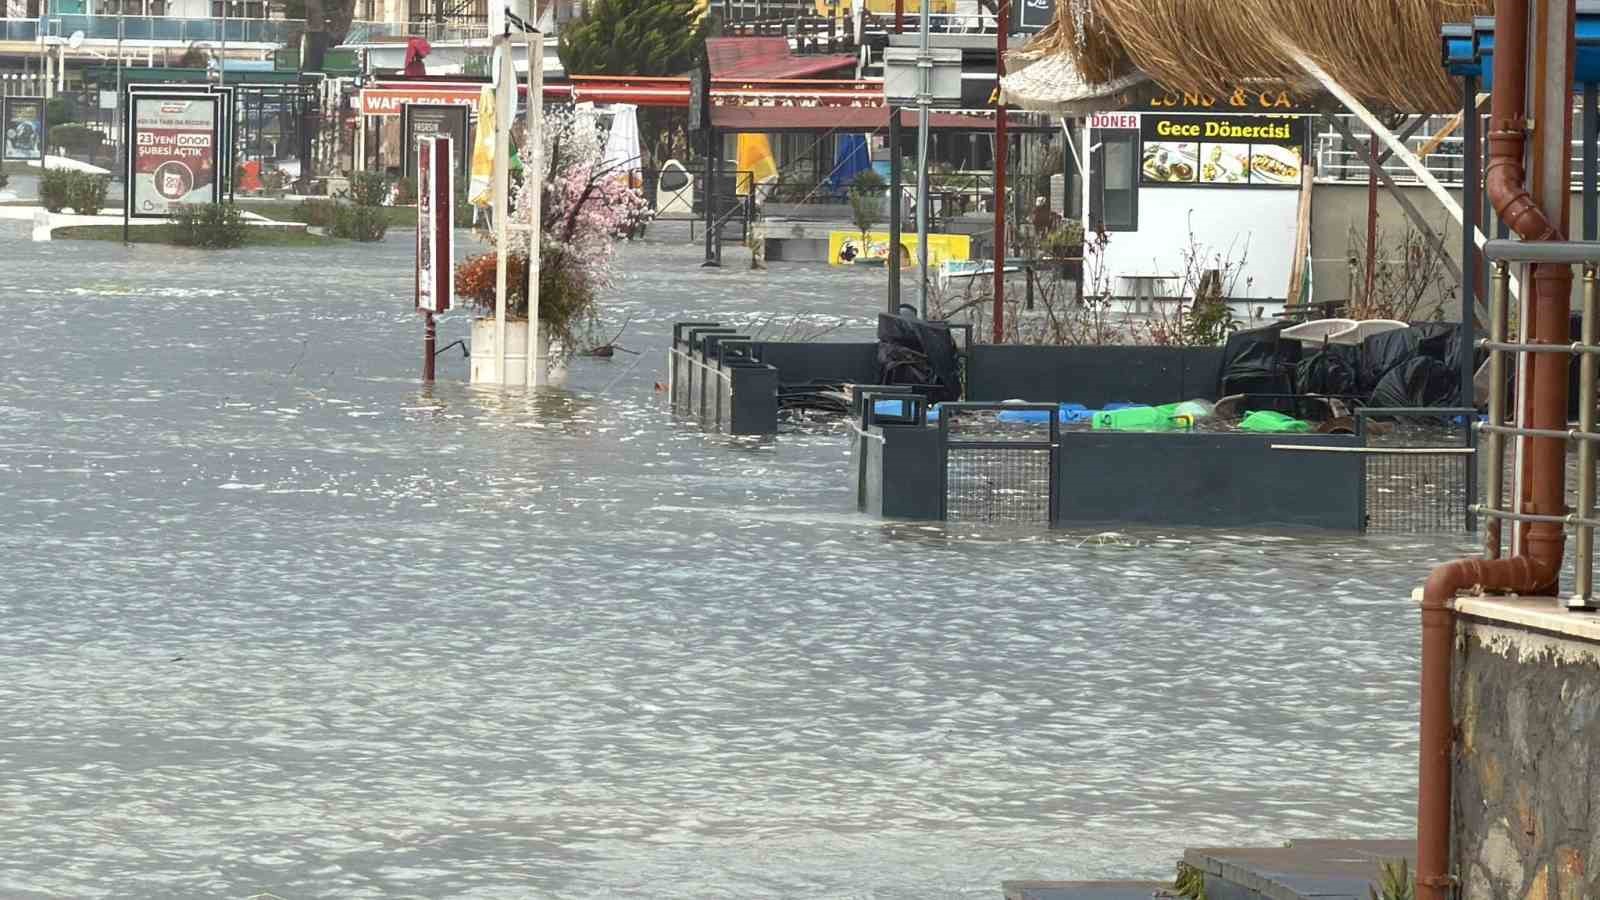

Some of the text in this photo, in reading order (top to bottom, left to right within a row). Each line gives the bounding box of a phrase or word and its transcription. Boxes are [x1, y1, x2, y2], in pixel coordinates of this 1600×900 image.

[1157, 121, 1291, 139] Gece Dönercisi
[139, 134, 152, 144] 23
[174, 147, 202, 158] AÇTIK
